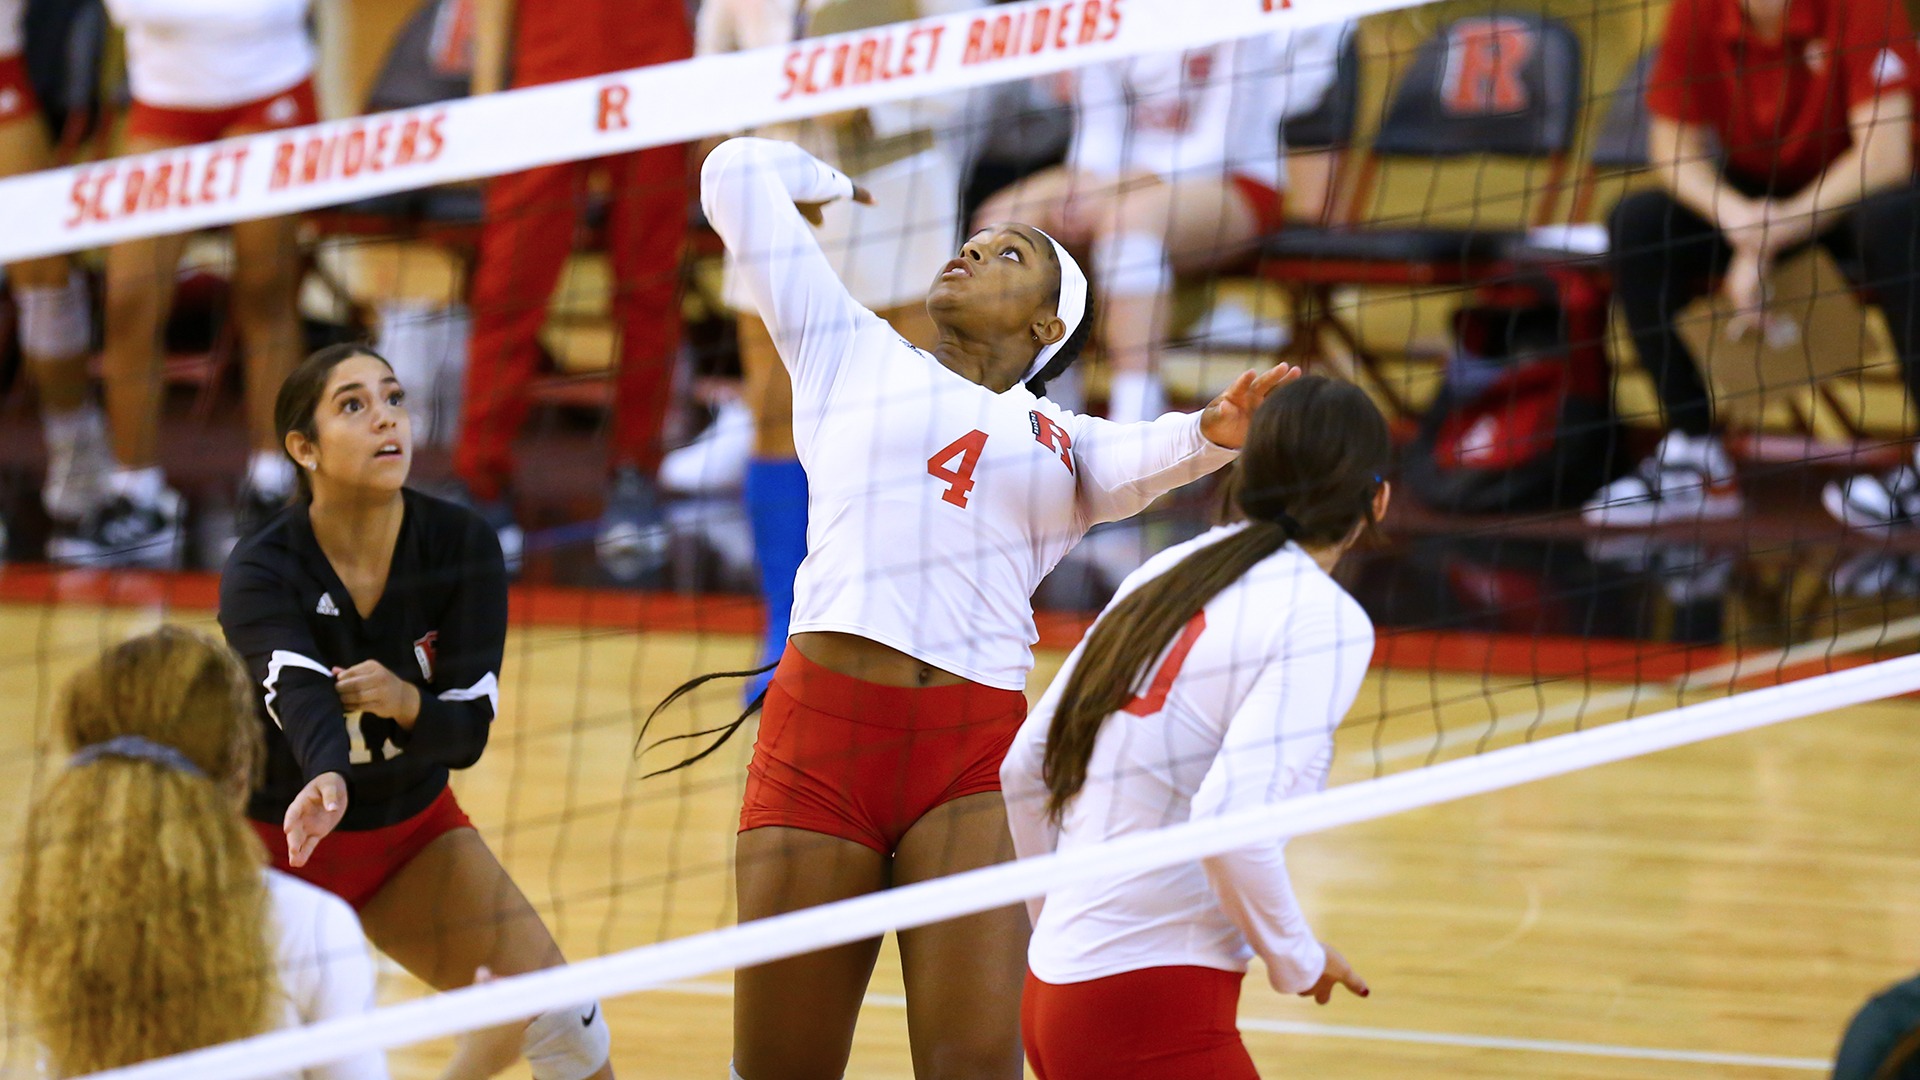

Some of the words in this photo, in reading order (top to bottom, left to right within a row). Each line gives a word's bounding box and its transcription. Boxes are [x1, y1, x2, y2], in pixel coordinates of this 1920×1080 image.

[780, 26, 944, 100] SCARLET
[962, 0, 1122, 65] RAIDERS
[1446, 18, 1533, 115] R
[598, 85, 629, 131] R
[66, 149, 249, 229] SCARLET
[269, 112, 447, 192] RAIDERS
[927, 429, 989, 509] 4
